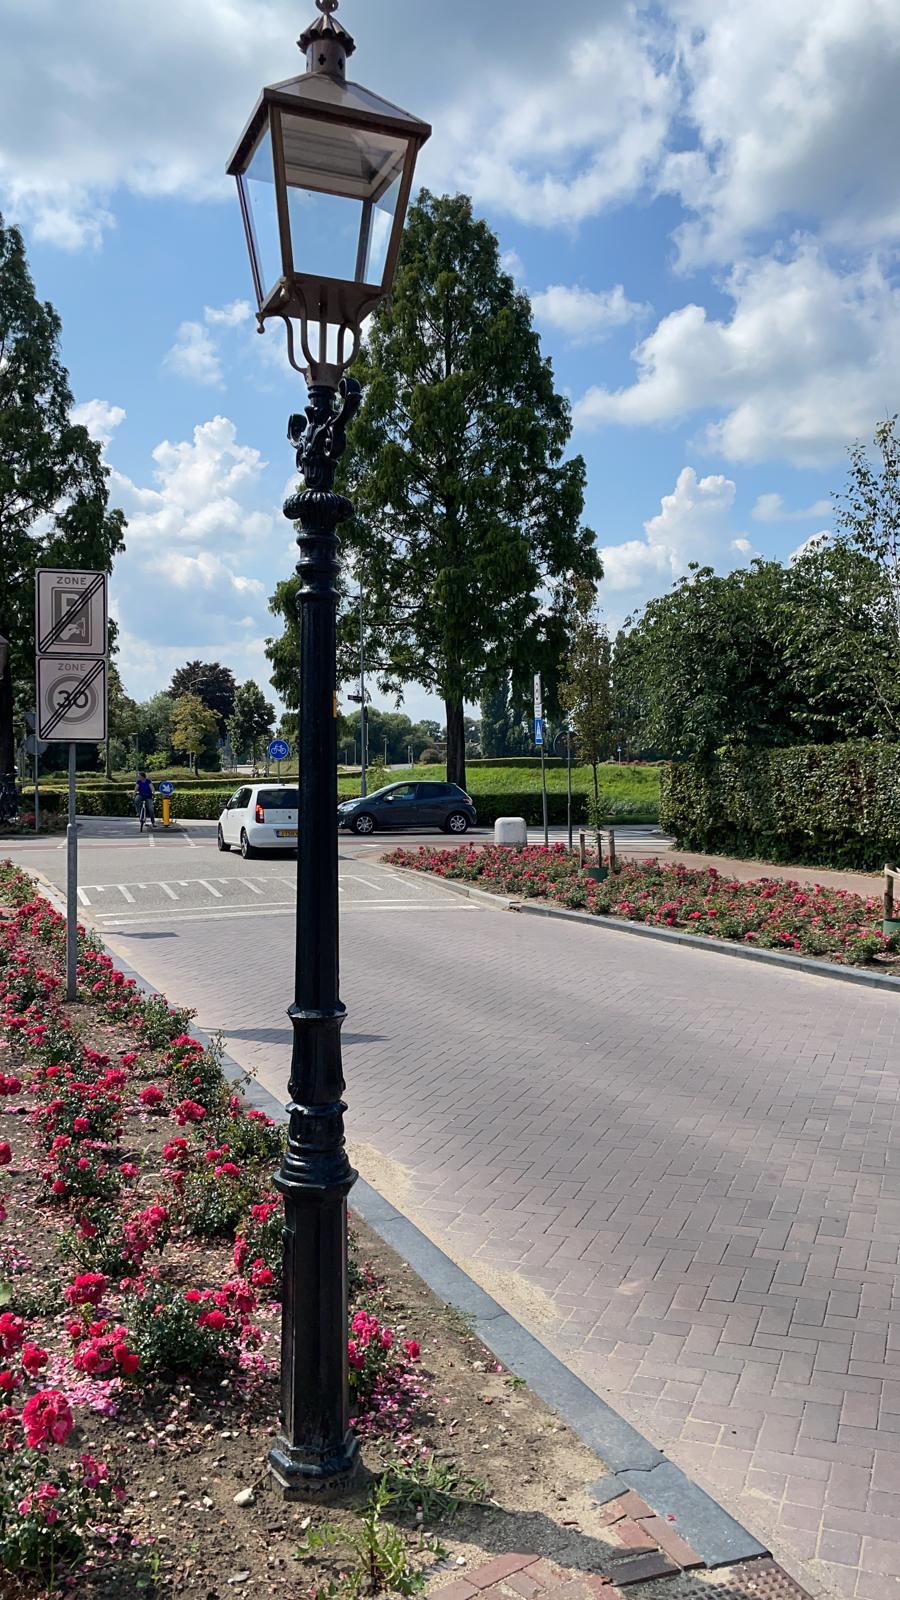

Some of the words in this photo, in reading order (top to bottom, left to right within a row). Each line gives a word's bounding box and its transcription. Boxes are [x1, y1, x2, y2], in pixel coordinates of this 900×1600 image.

[56, 576, 87, 586] ZONE
[57, 663, 86, 671] ZONE
[57, 690, 89, 709] 30
